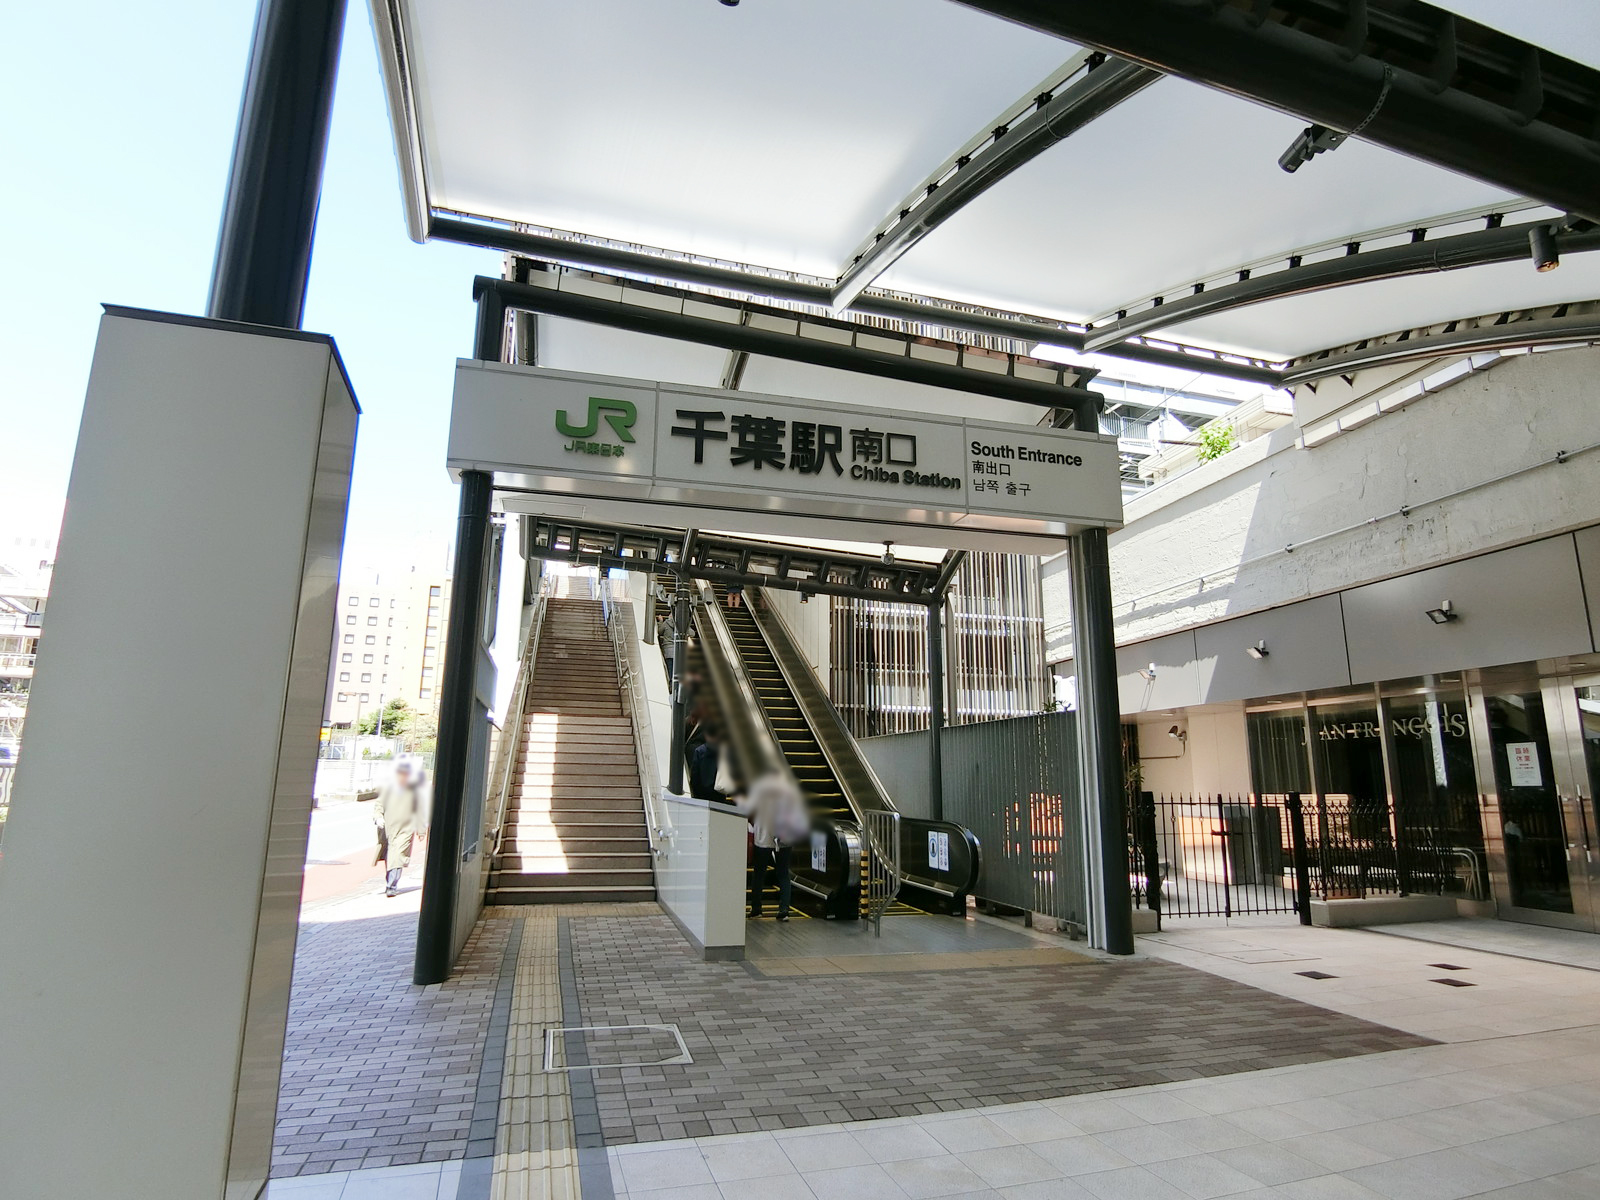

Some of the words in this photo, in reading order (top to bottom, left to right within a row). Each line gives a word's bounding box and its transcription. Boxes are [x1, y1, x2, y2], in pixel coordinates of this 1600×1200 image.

[555, 396, 637, 443] JR
[564, 440, 625, 457] JR東日本
[671, 409, 844, 476] 千葉駅
[849, 427, 916, 466] 南口
[971, 441, 1015, 460] South
[1018, 447, 1083, 466] Entrance
[850, 464, 900, 483] Chiba
[903, 469, 961, 489] Station
[972, 460, 1011, 476] 南出口
[973, 478, 1000, 494] 남쪽
[1005, 481, 1032, 496] 출구
[1301, 723, 1346, 746] JAN
[1351, 713, 1466, 740] FRNÇOIS
